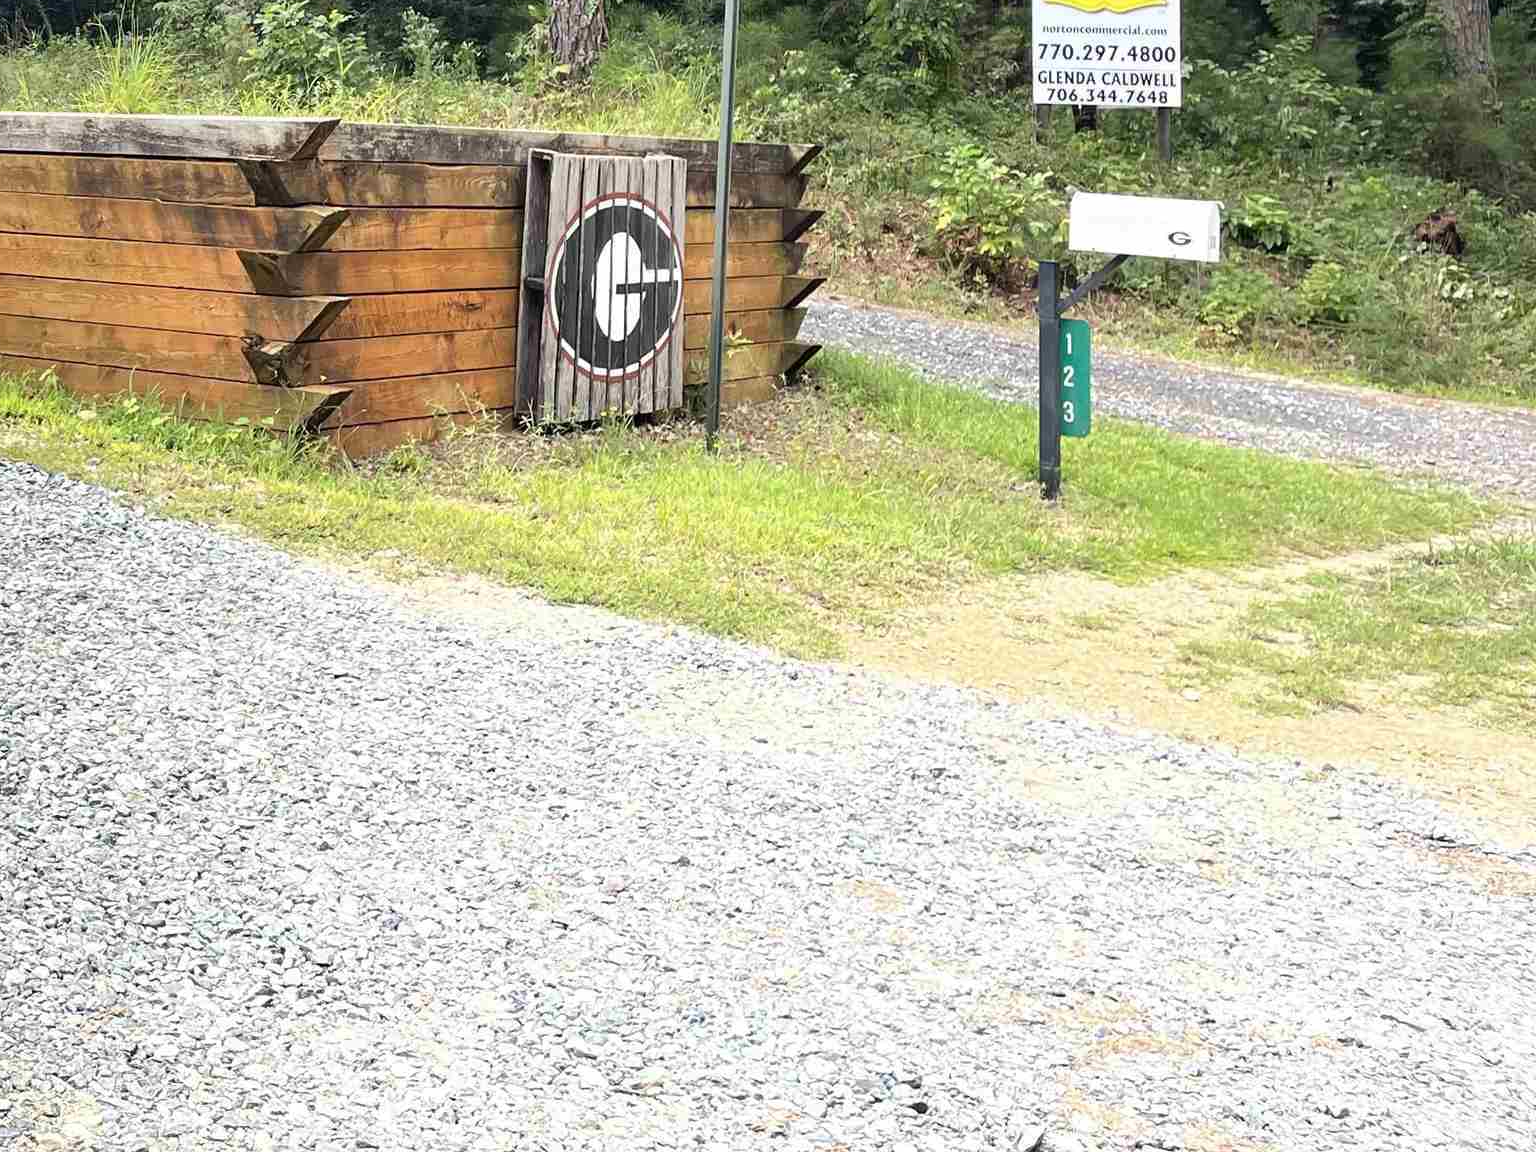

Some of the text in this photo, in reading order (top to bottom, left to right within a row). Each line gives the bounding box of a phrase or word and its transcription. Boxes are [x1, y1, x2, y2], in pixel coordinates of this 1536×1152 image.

[1042, 24, 1168, 36] nortoncommercial.com
[1038, 43, 1176, 63] 770.297.4800
[1038, 70, 1176, 87] GLENDA CALDWELL
[1047, 88, 1168, 104] 706.344.7648
[1167, 231, 1192, 246] G
[552, 205, 681, 370] G
[1062, 333, 1076, 423] 123
